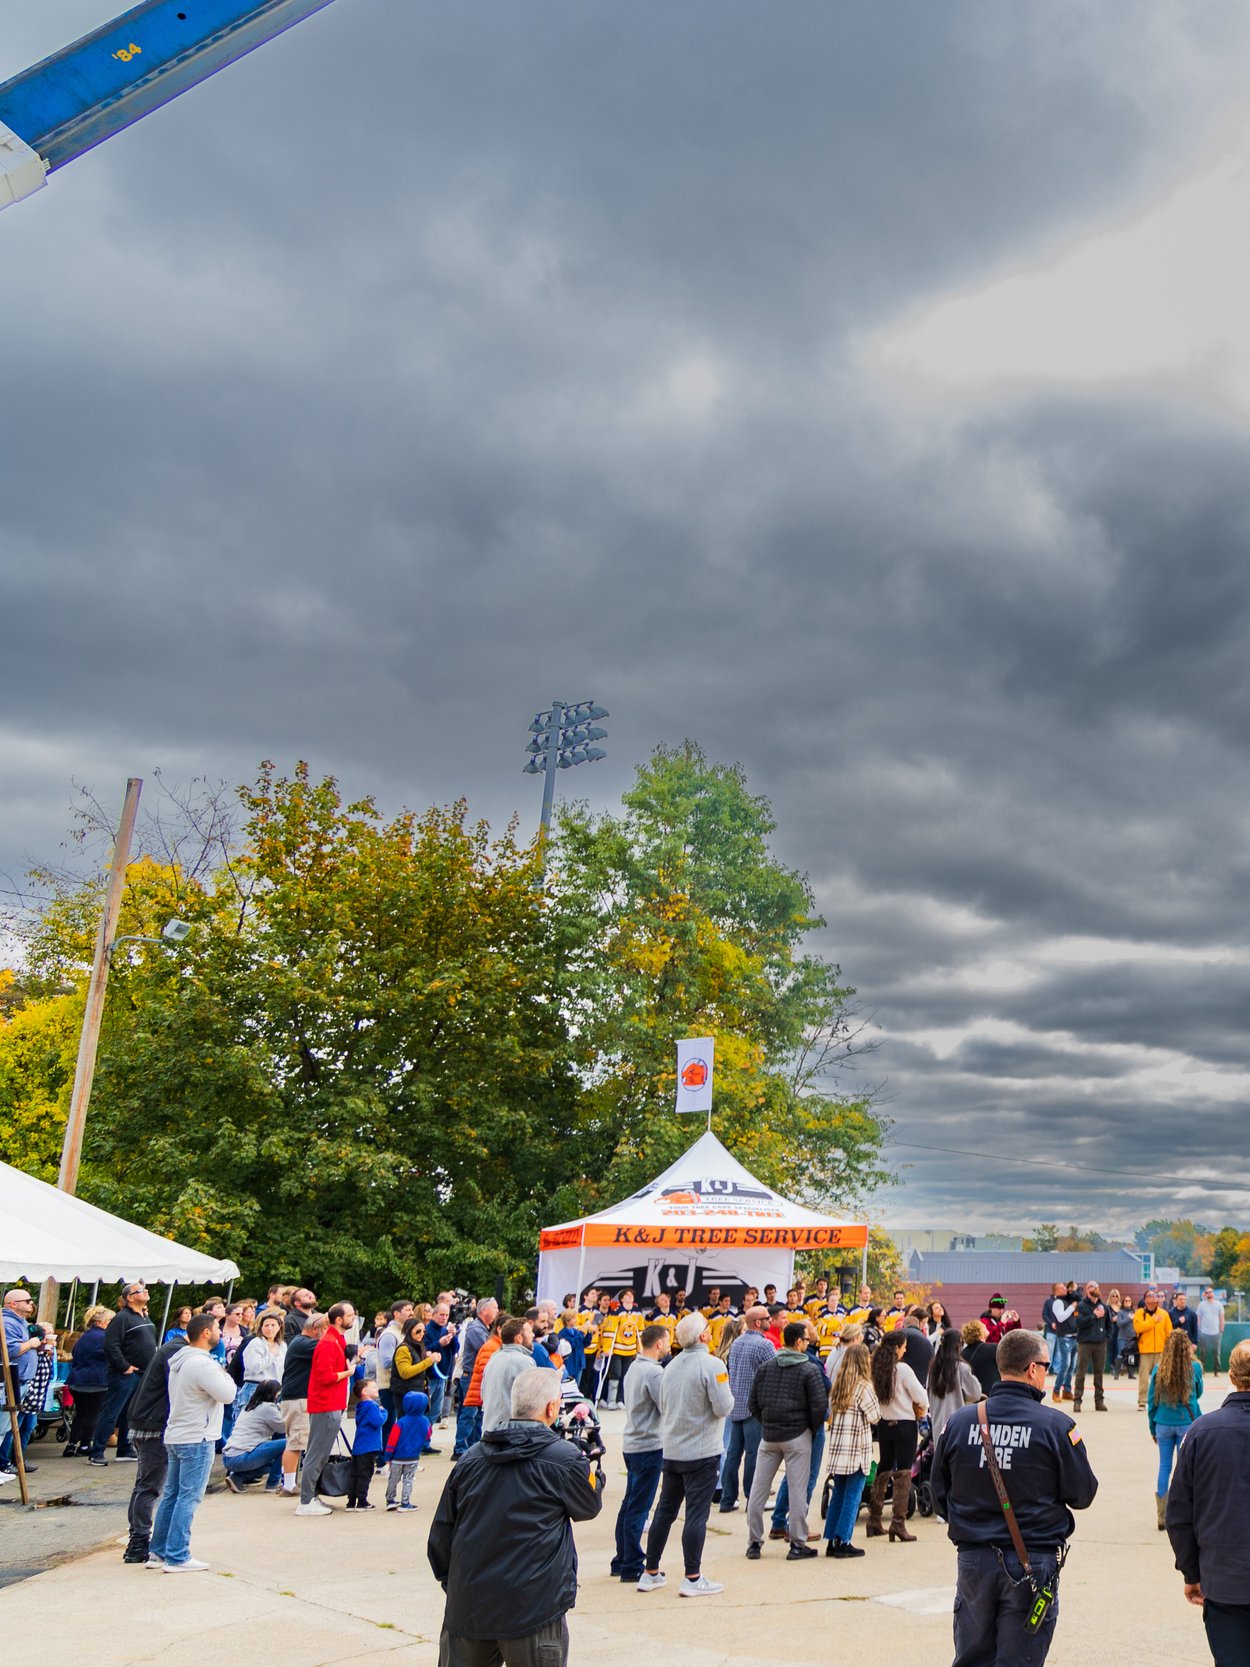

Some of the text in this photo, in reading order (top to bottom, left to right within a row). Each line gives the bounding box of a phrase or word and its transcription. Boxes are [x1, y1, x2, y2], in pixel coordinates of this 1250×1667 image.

[111, 43, 142, 62] '84
[700, 1178, 733, 1194] K&J
[613, 1227, 842, 1245] K&J TREE SERVICE
[979, 1446, 1013, 1470] FRE
